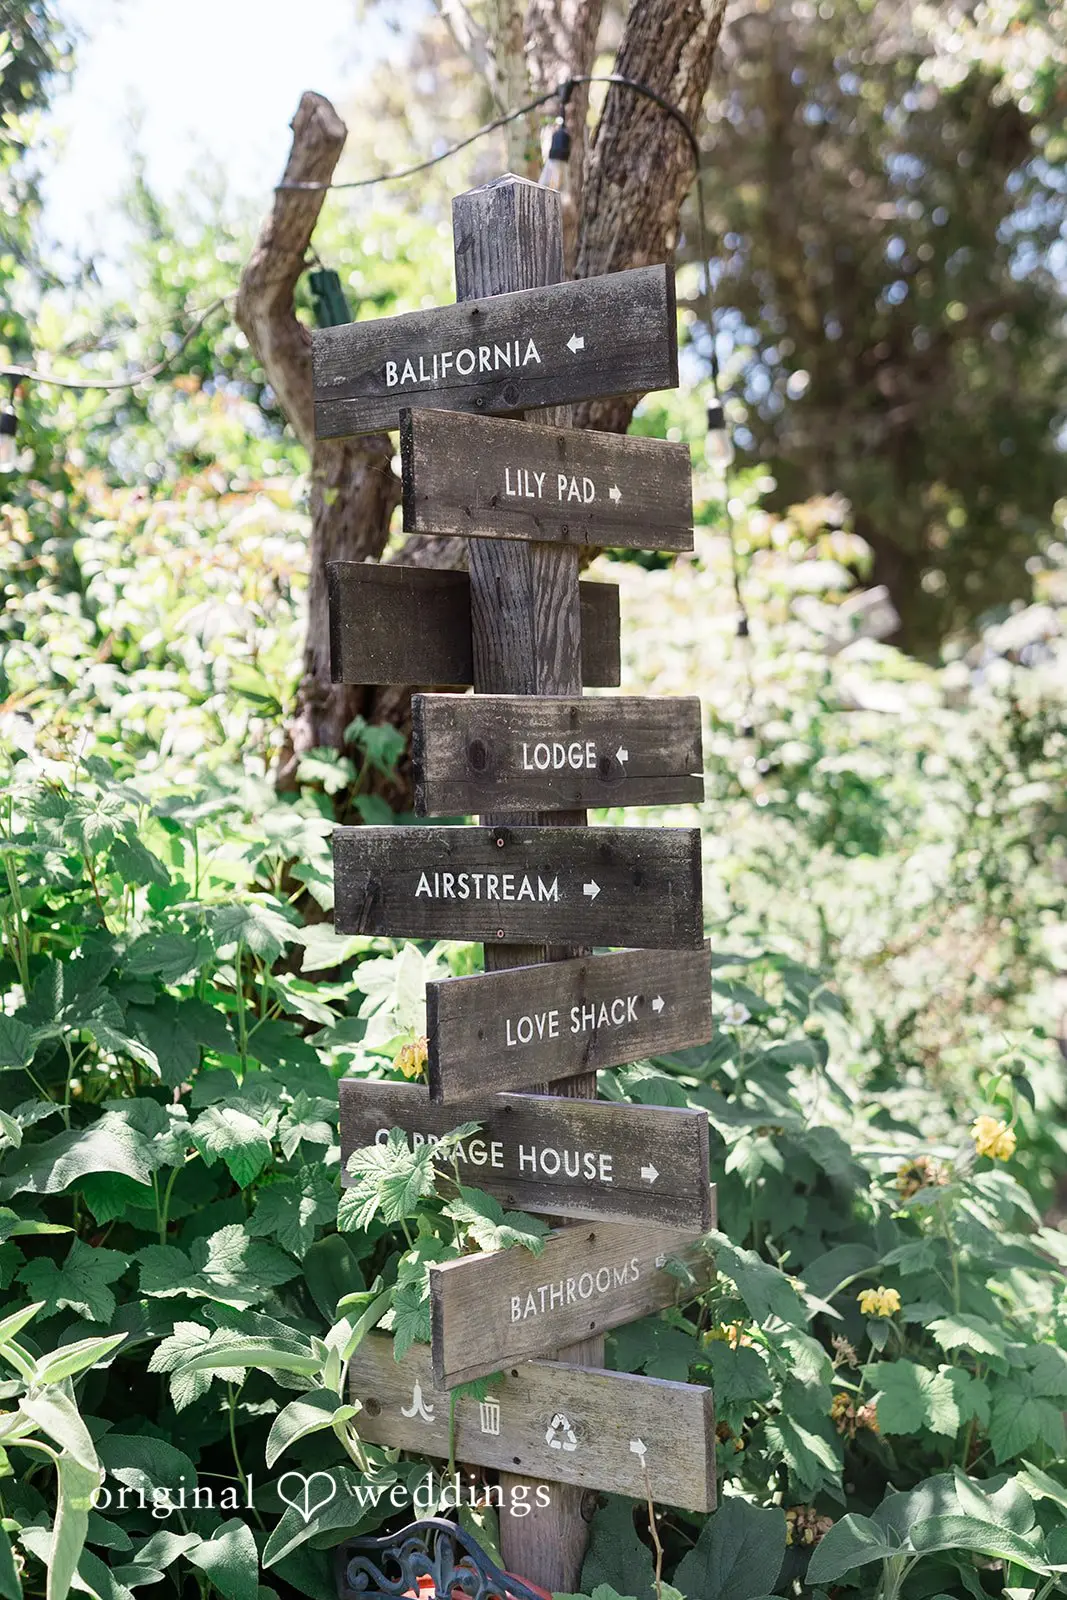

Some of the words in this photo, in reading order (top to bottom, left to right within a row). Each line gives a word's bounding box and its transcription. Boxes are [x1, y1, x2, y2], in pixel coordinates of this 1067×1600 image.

[386, 339, 541, 387] BALIFORNIA
[504, 467, 547, 497] LILY
[557, 474, 596, 504] PAD
[522, 742, 597, 771] LODGE
[415, 872, 560, 902] AIRSTREAM
[505, 1009, 560, 1047] LOVE
[570, 995, 639, 1034] SHACK
[519, 1145, 613, 1182] HOUSE
[510, 1257, 641, 1324] BATHROOMS
